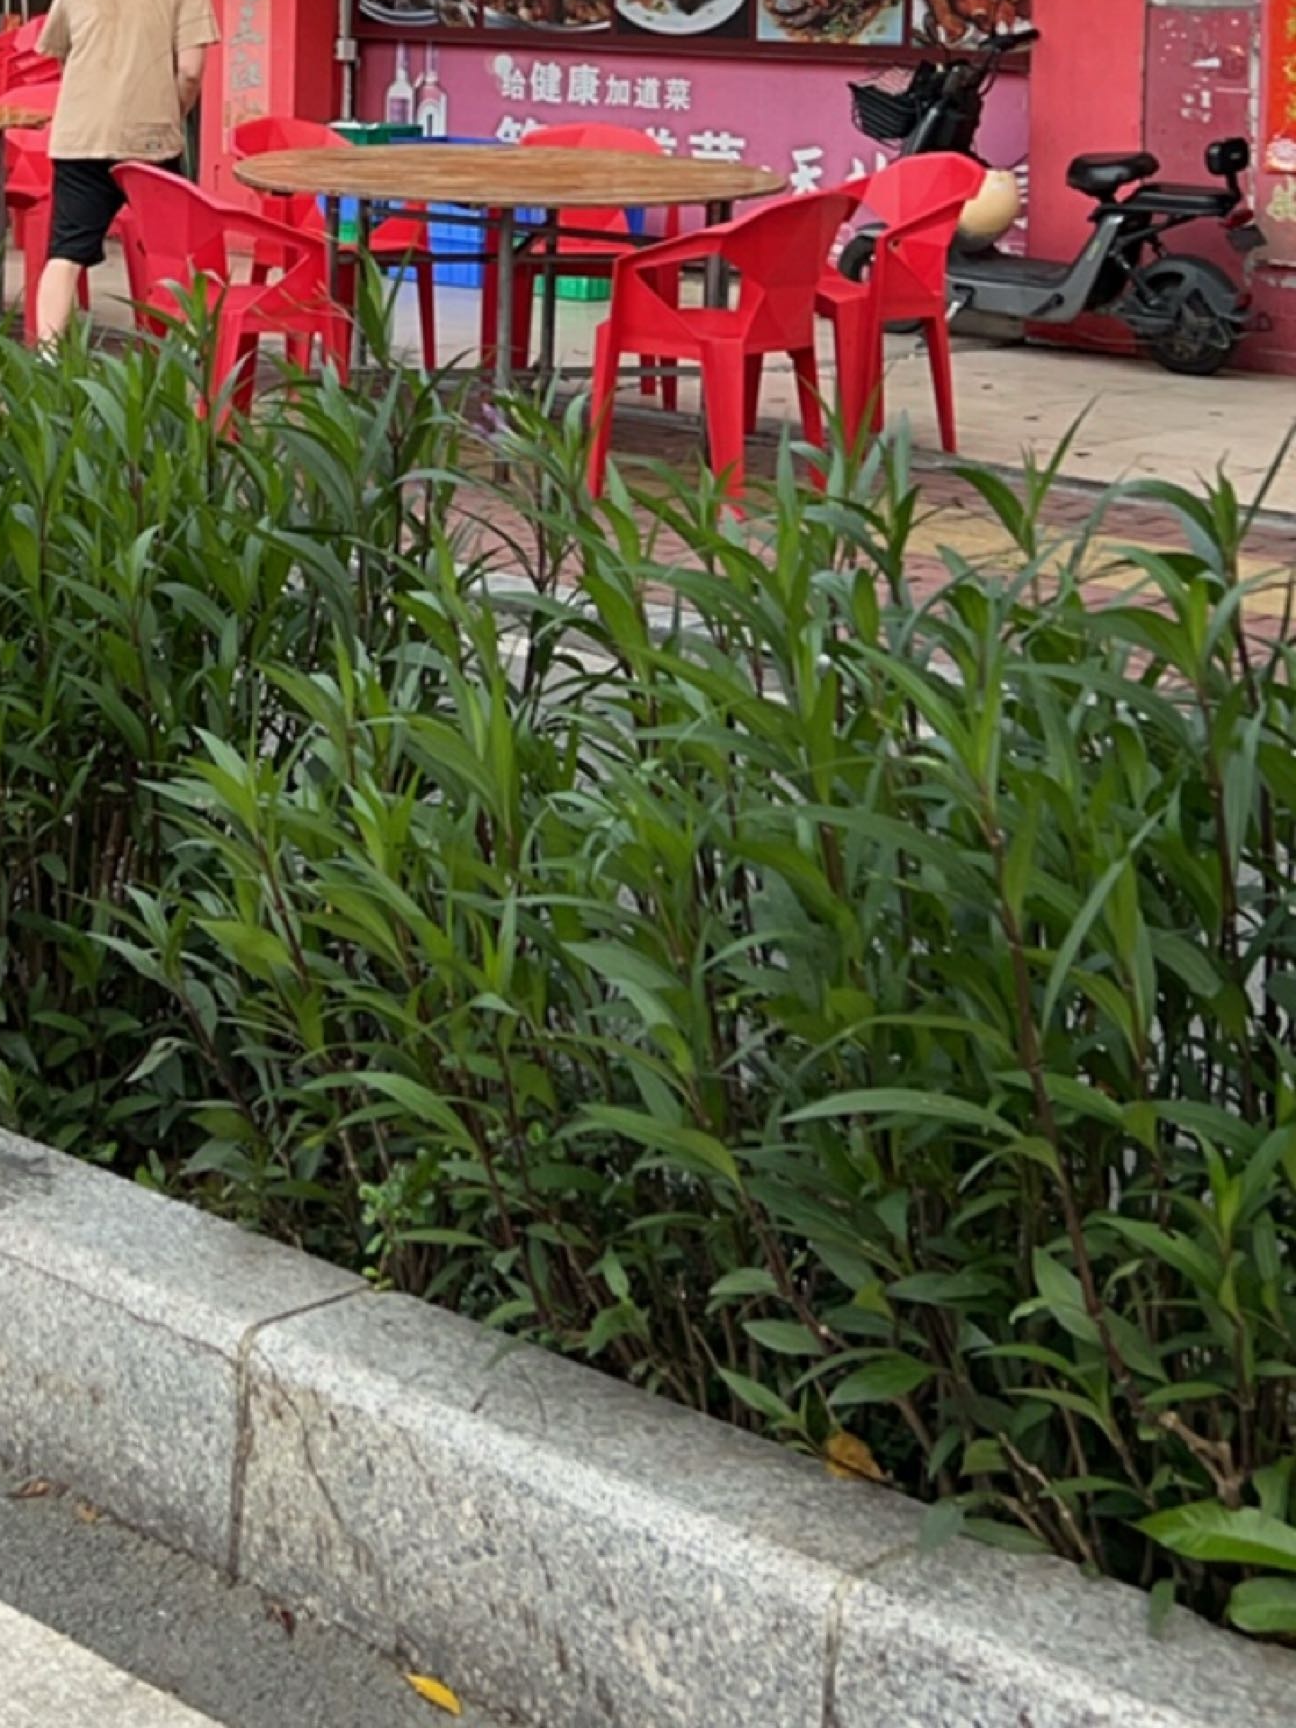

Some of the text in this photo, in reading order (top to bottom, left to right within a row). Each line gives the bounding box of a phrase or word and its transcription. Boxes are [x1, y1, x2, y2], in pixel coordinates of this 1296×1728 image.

[501, 60, 692, 112] 给健康加道菜
